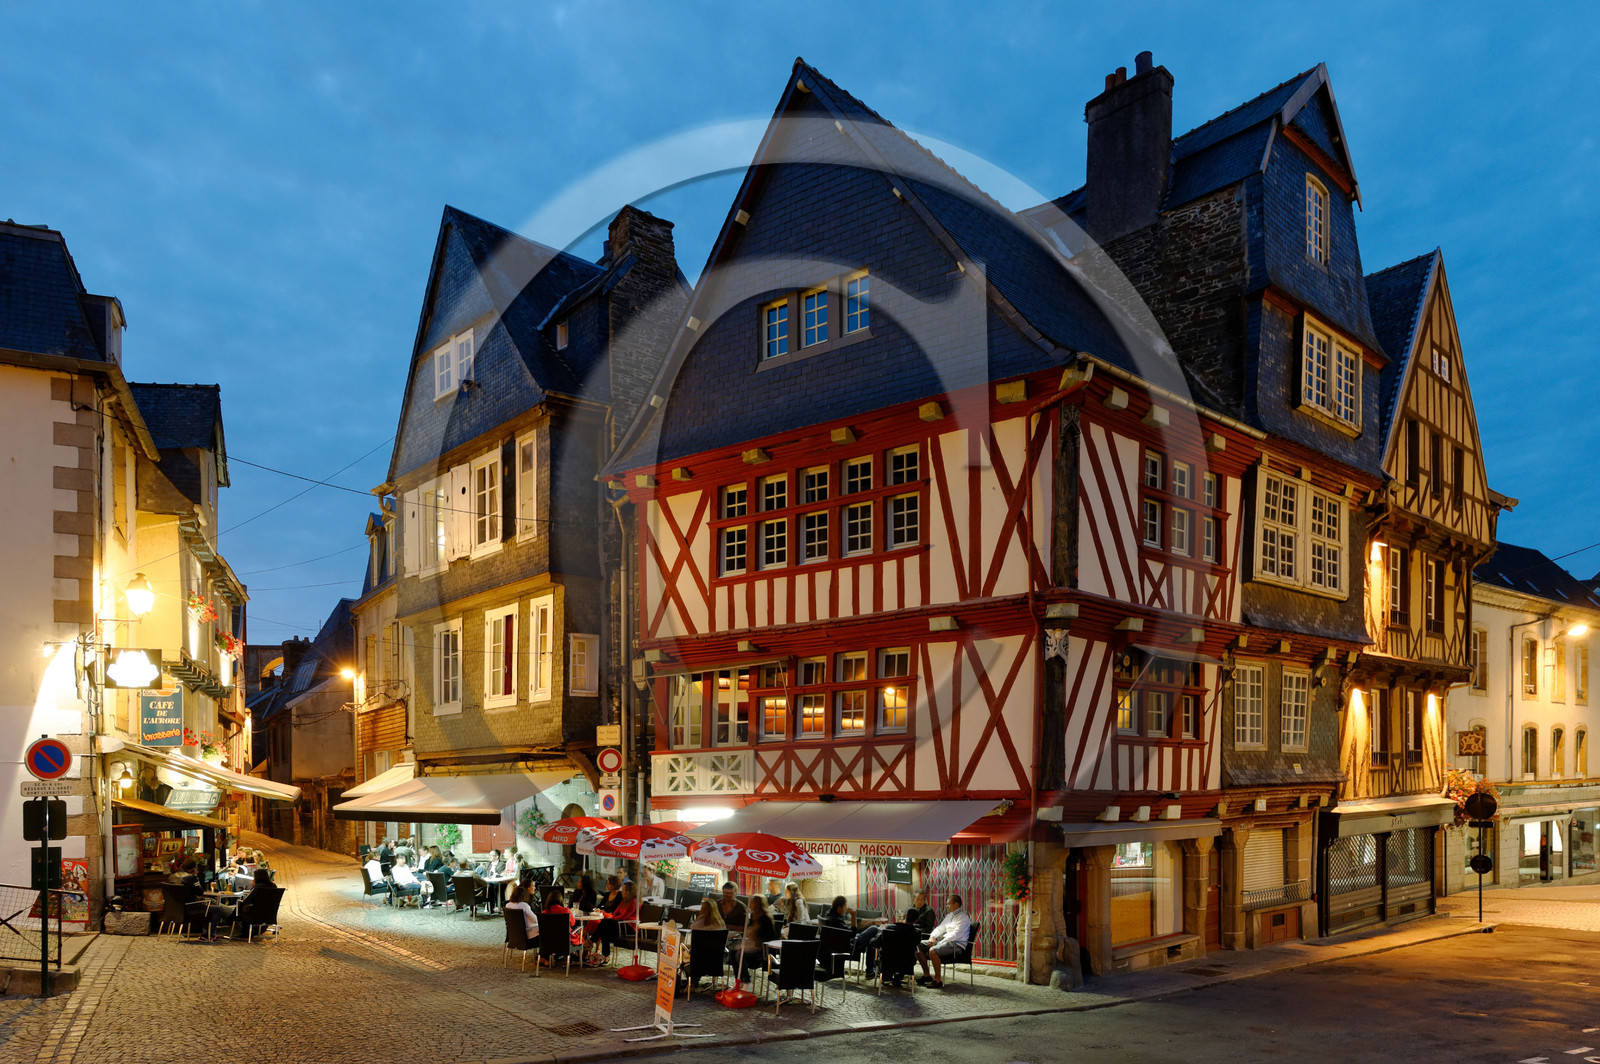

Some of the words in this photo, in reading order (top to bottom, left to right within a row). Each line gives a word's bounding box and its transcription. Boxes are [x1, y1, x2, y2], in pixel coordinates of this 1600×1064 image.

[149, 701, 175, 710] CAFE
[551, 835, 569, 843] MIKO
[860, 844, 902, 857] MAISON
